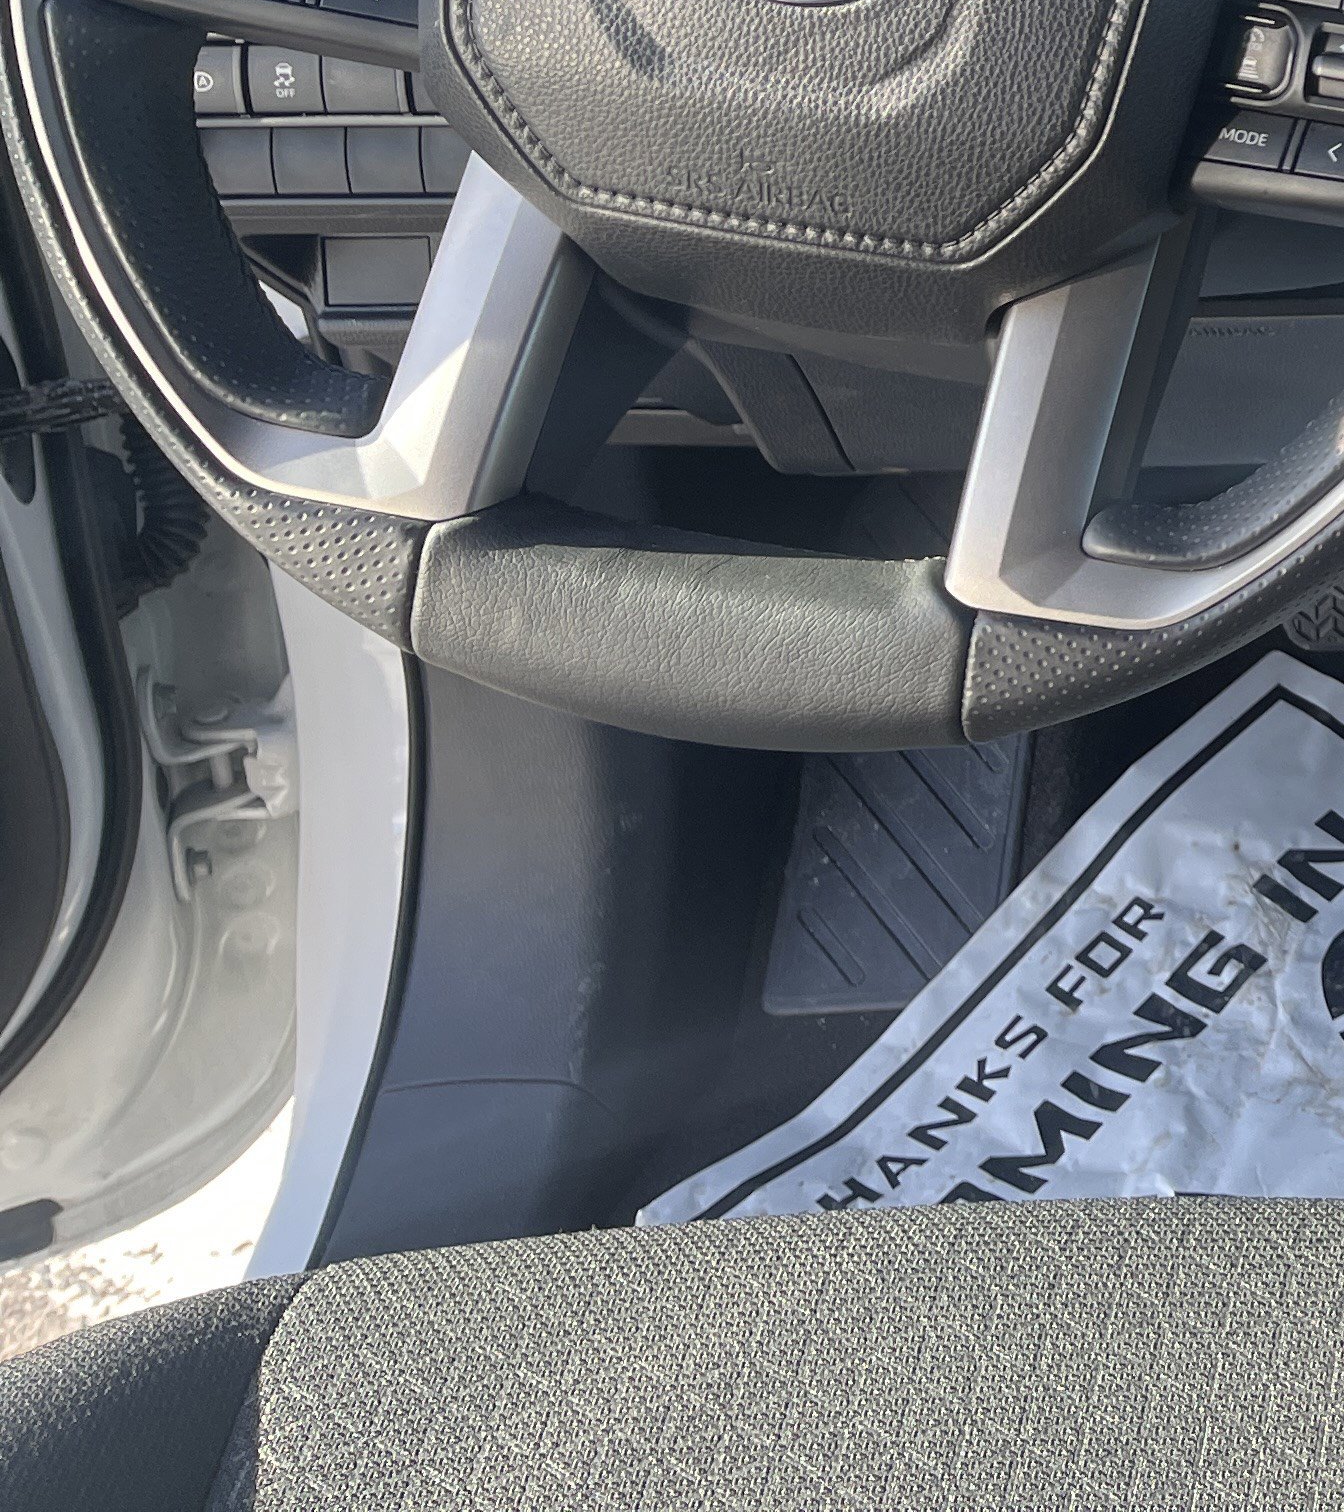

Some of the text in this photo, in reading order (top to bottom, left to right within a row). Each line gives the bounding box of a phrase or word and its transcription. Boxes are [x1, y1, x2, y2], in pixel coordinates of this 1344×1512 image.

[275, 88, 296, 99] OFF
[1218, 127, 1268, 148] MODE
[815, 896, 1166, 1211] HANKS FOR
[939, 929, 1268, 1202] MING
